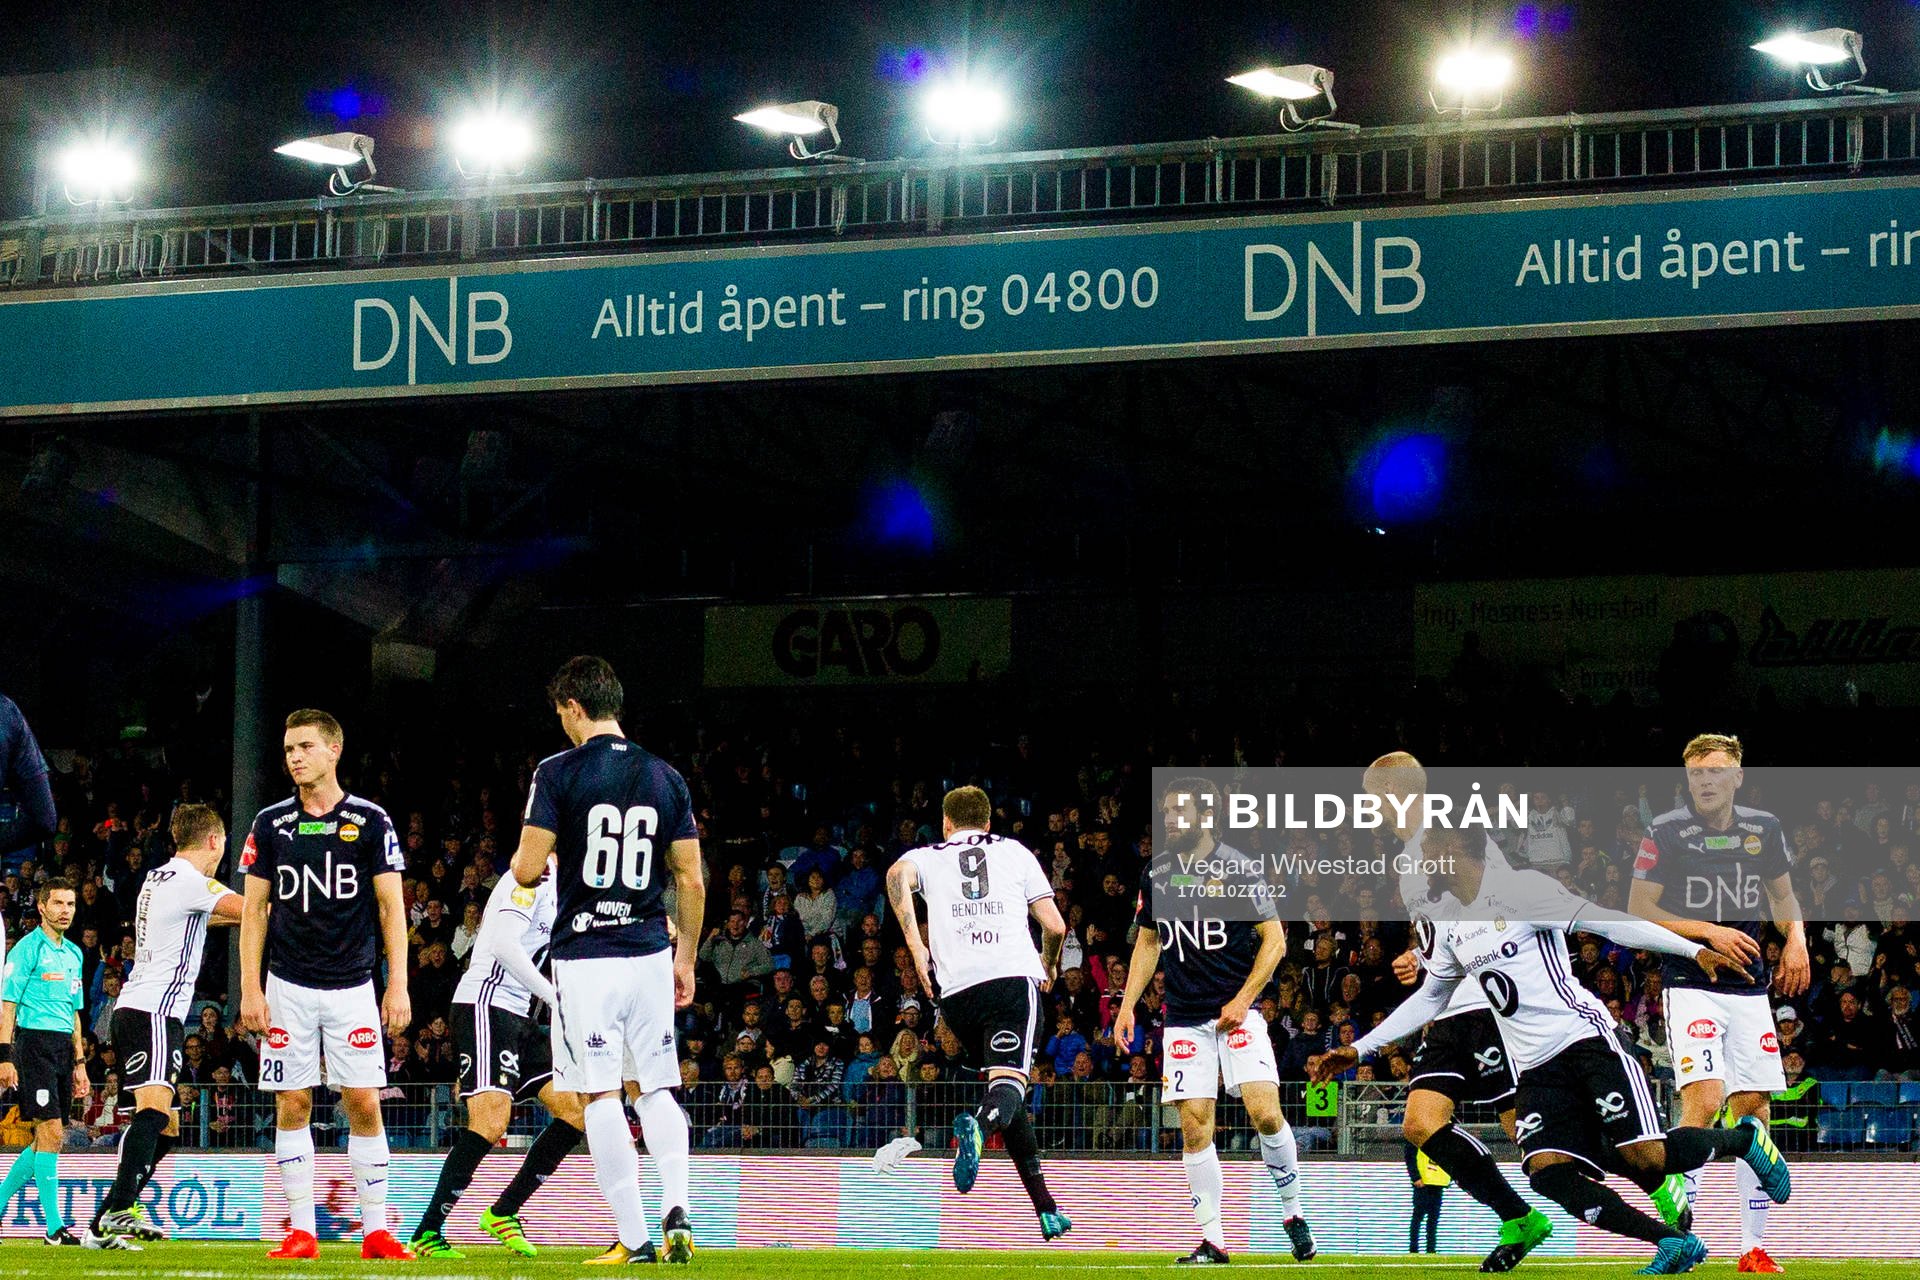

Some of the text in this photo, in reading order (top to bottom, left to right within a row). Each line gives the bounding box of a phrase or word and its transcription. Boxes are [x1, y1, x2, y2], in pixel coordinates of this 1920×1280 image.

[1515, 235, 1642, 287] Alltid
[1660, 229, 1805, 289] åpent
[1244, 221, 1426, 336] DNB
[592, 291, 702, 339] Alltid
[718, 285, 846, 341] åpent
[903, 278, 986, 330] ring
[1002, 266, 1159, 317] 04800
[353, 277, 512, 385] DNB
[772, 606, 940, 679] GARO
[582, 804, 658, 890] 66
[277, 851, 358, 913] DNB
[959, 847, 989, 900] 9
[1686, 862, 1761, 922] DNB
[596, 901, 632, 917] HOVEN
[952, 902, 1004, 917] BENDTNER
[1158, 905, 1228, 962] DNB
[1464, 949, 1501, 975] areBank
[270, 1032, 290, 1044] RBO
[349, 1032, 378, 1044] ARBO
[1689, 1023, 1718, 1035] ARBO
[1169, 1043, 1198, 1056] ARBO
[1703, 1049, 1713, 1072] 3
[262, 1058, 283, 1082] 28
[1175, 1071, 1184, 1092] 2
[1315, 1088, 1329, 1111] 3
